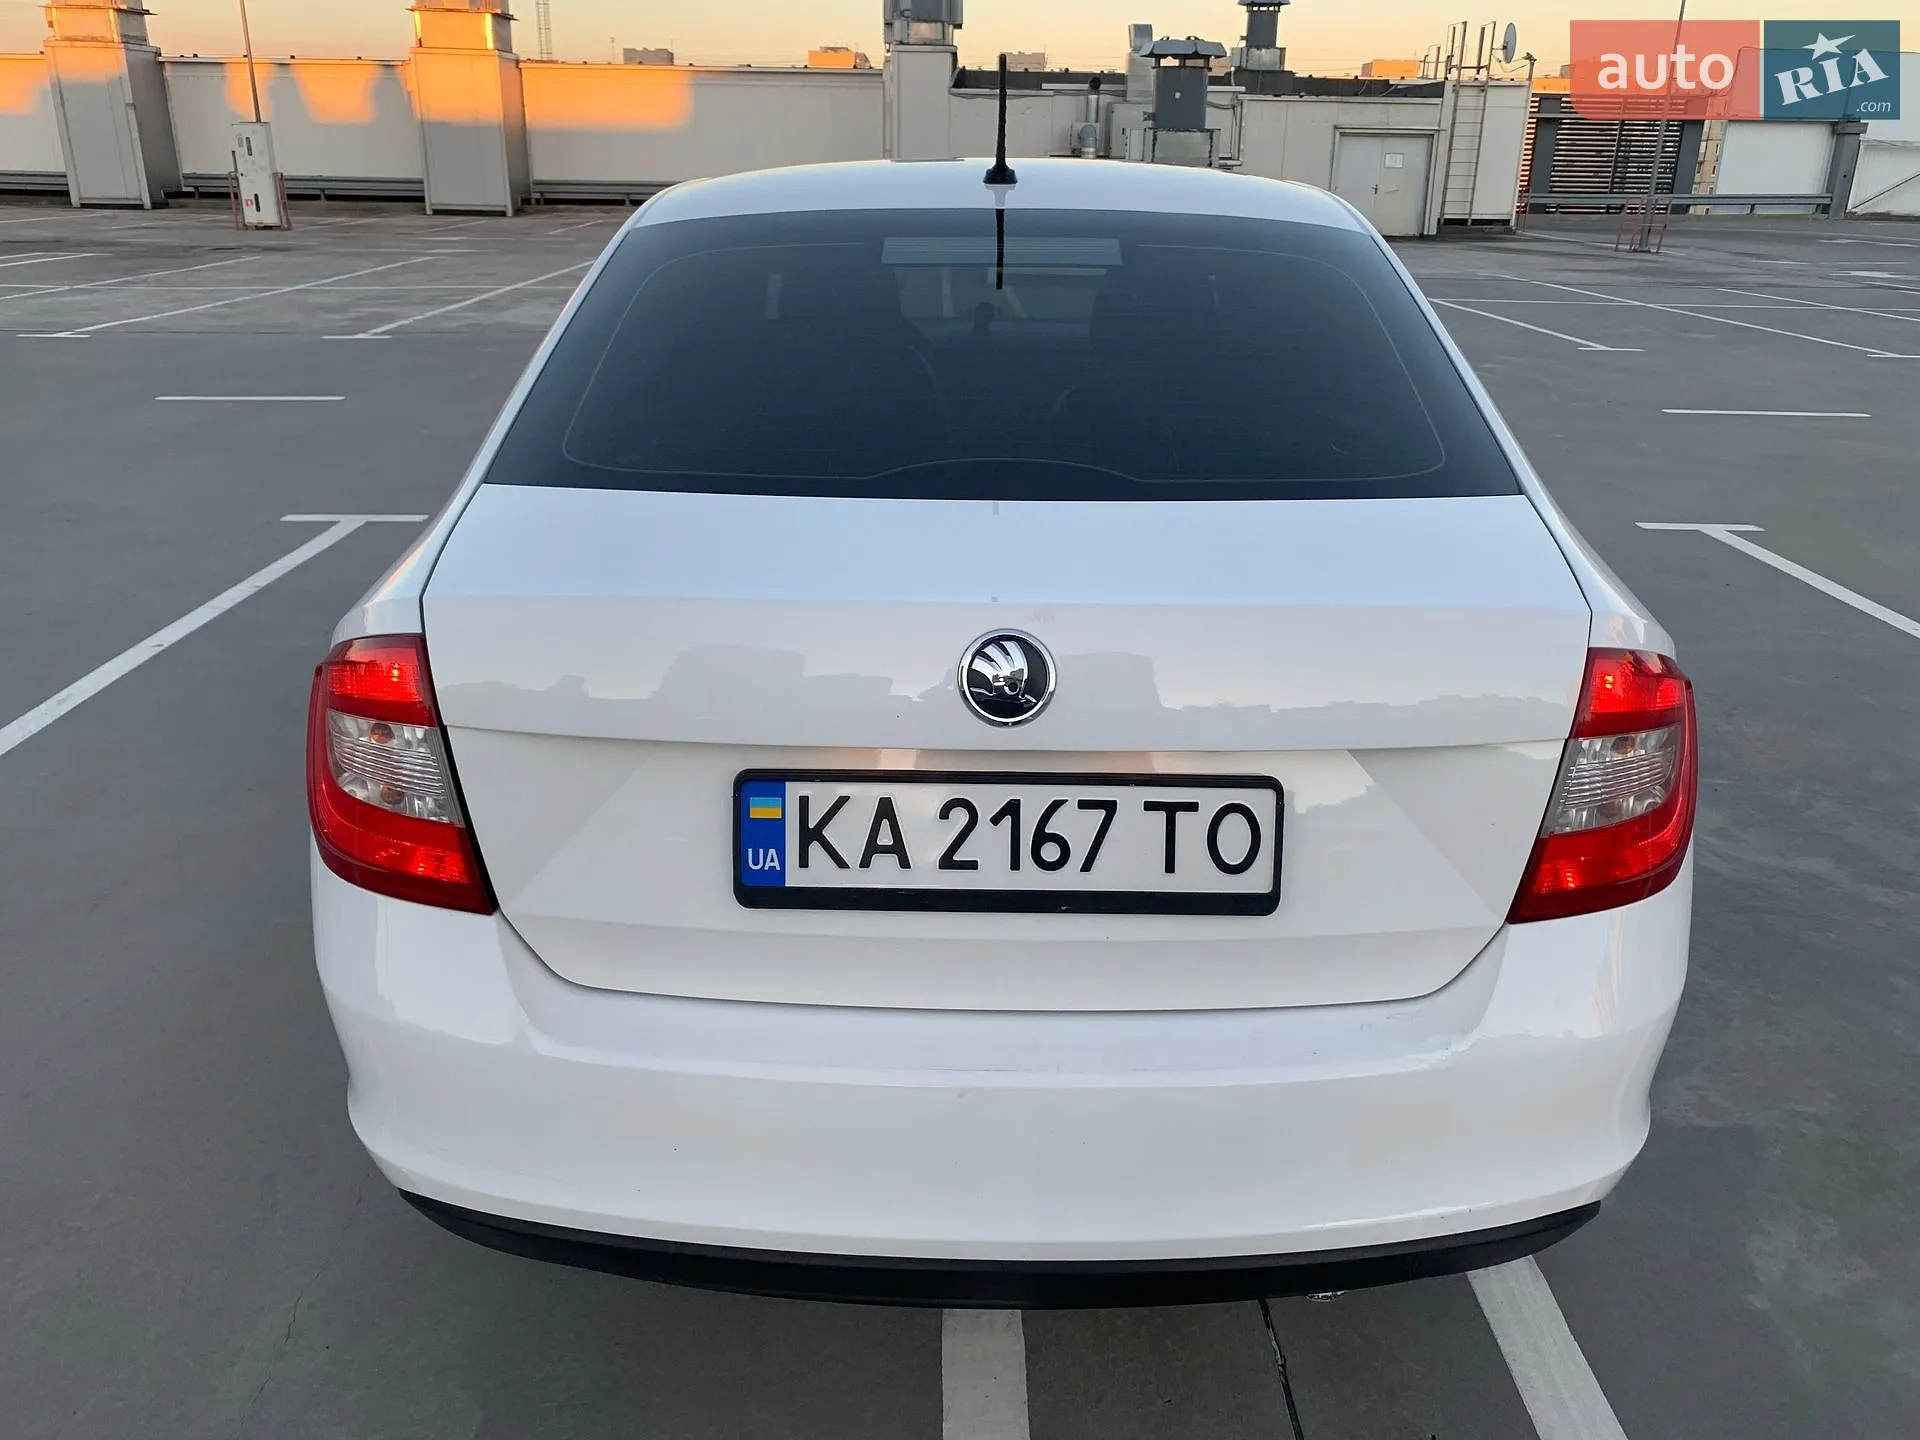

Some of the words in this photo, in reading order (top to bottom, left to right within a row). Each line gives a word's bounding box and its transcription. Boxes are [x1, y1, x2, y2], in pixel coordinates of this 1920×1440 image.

[747, 848, 781, 871] UA
[798, 795, 912, 870] KA
[937, 797, 1118, 873] 2167
[1143, 800, 1262, 876] TO
